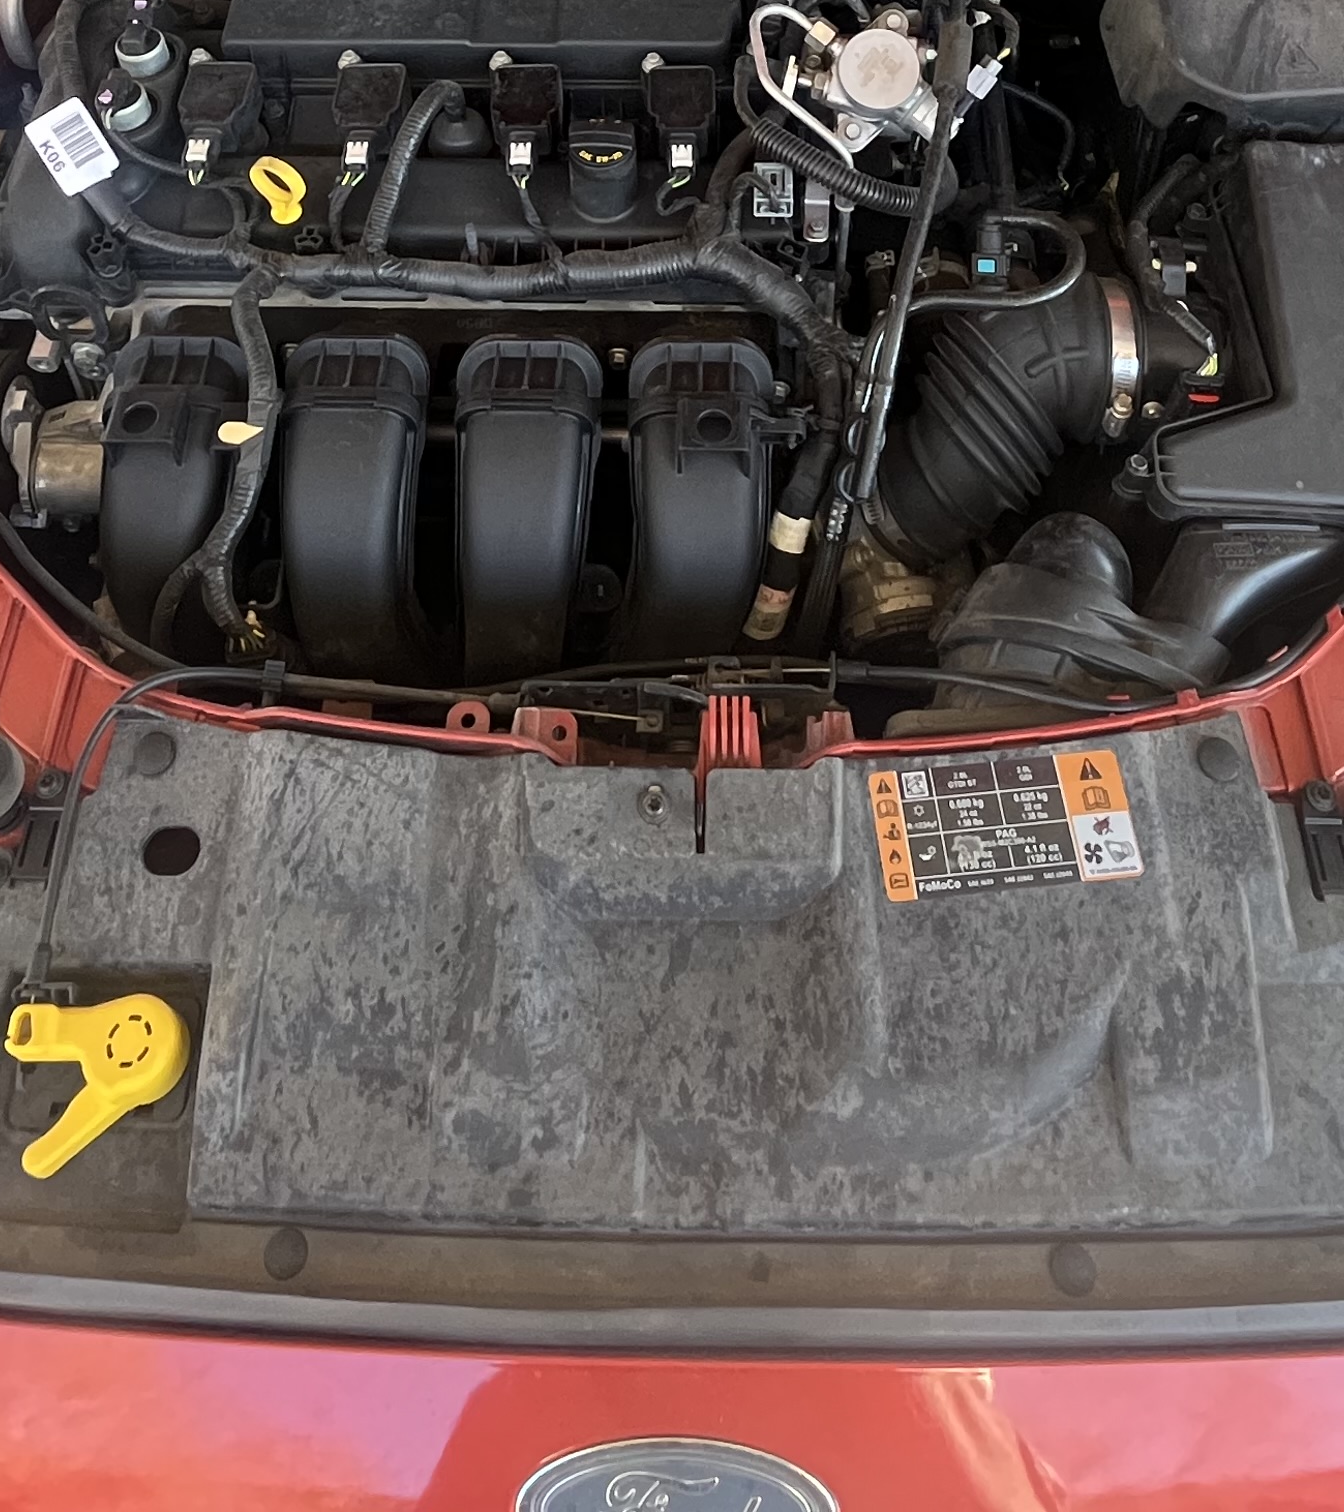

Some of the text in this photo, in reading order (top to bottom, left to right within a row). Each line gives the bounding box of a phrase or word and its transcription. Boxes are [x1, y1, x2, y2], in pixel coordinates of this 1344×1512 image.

[38, 139, 66, 173] K06
[1036, 790, 1049, 803] kg
[972, 797, 985, 809] kg
[995, 827, 1017, 839] PAG
[1047, 843, 1060, 852] oz
[1026, 851, 1063, 867] (120 cc)
